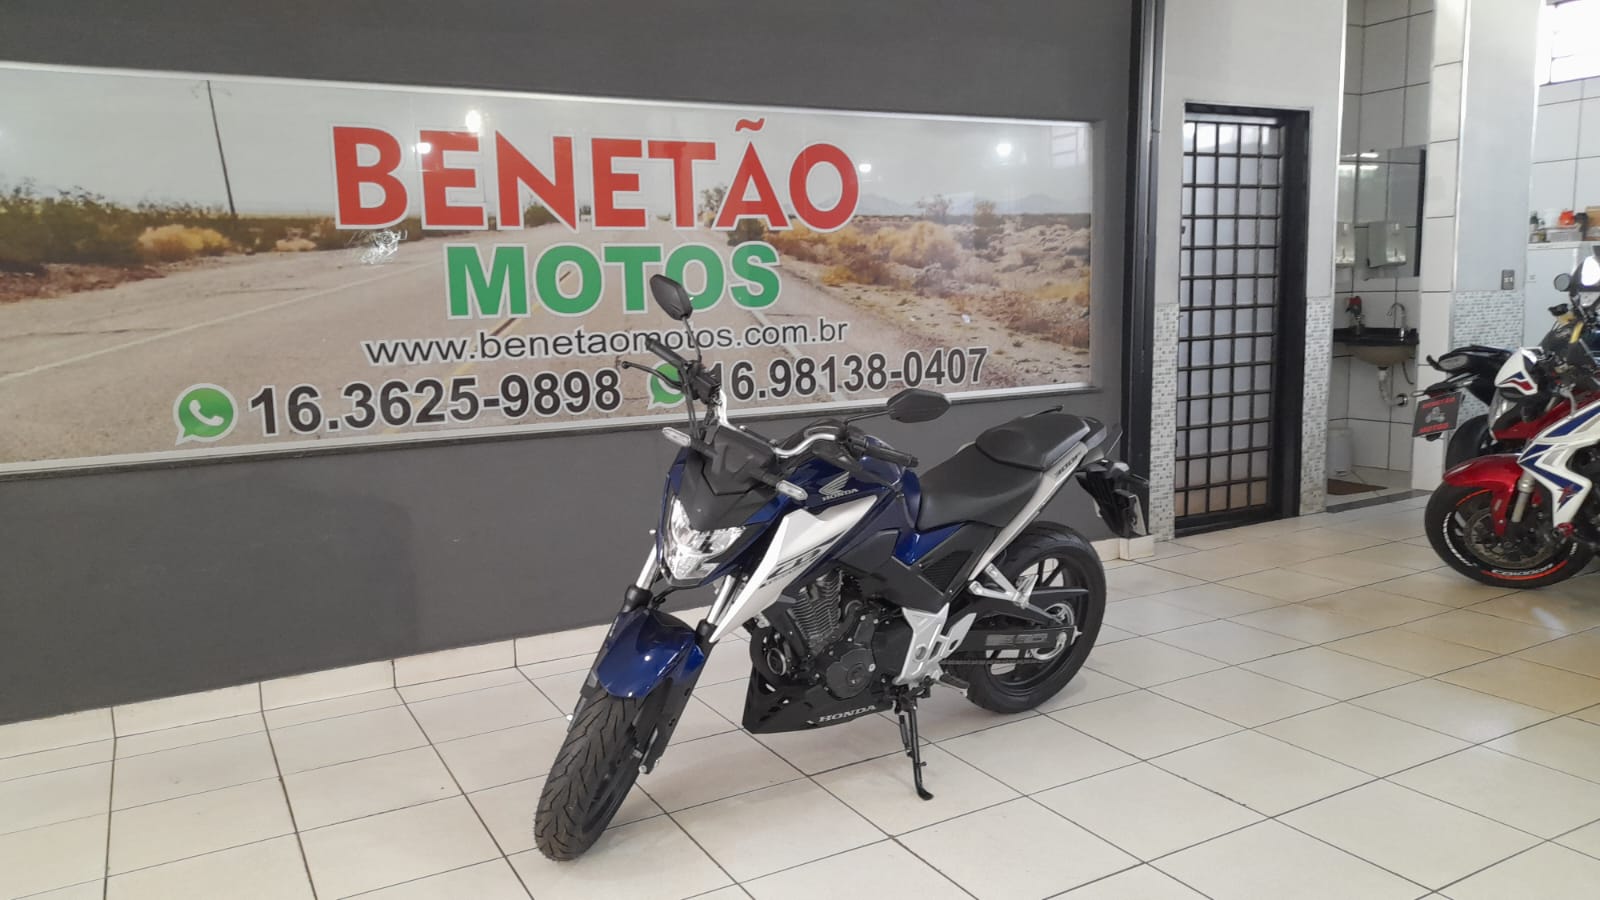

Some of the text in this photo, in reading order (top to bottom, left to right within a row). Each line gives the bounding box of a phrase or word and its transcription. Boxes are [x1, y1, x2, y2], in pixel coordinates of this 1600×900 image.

[332, 118, 860, 230] BENETÃO
[446, 243, 780, 317] MOTOS
[365, 319, 848, 364] www.benetaomotos.com.br
[249, 369, 621, 435] 16.3625-9898
[822, 488, 859, 502] HONDA
[819, 705, 877, 722] HONDA
